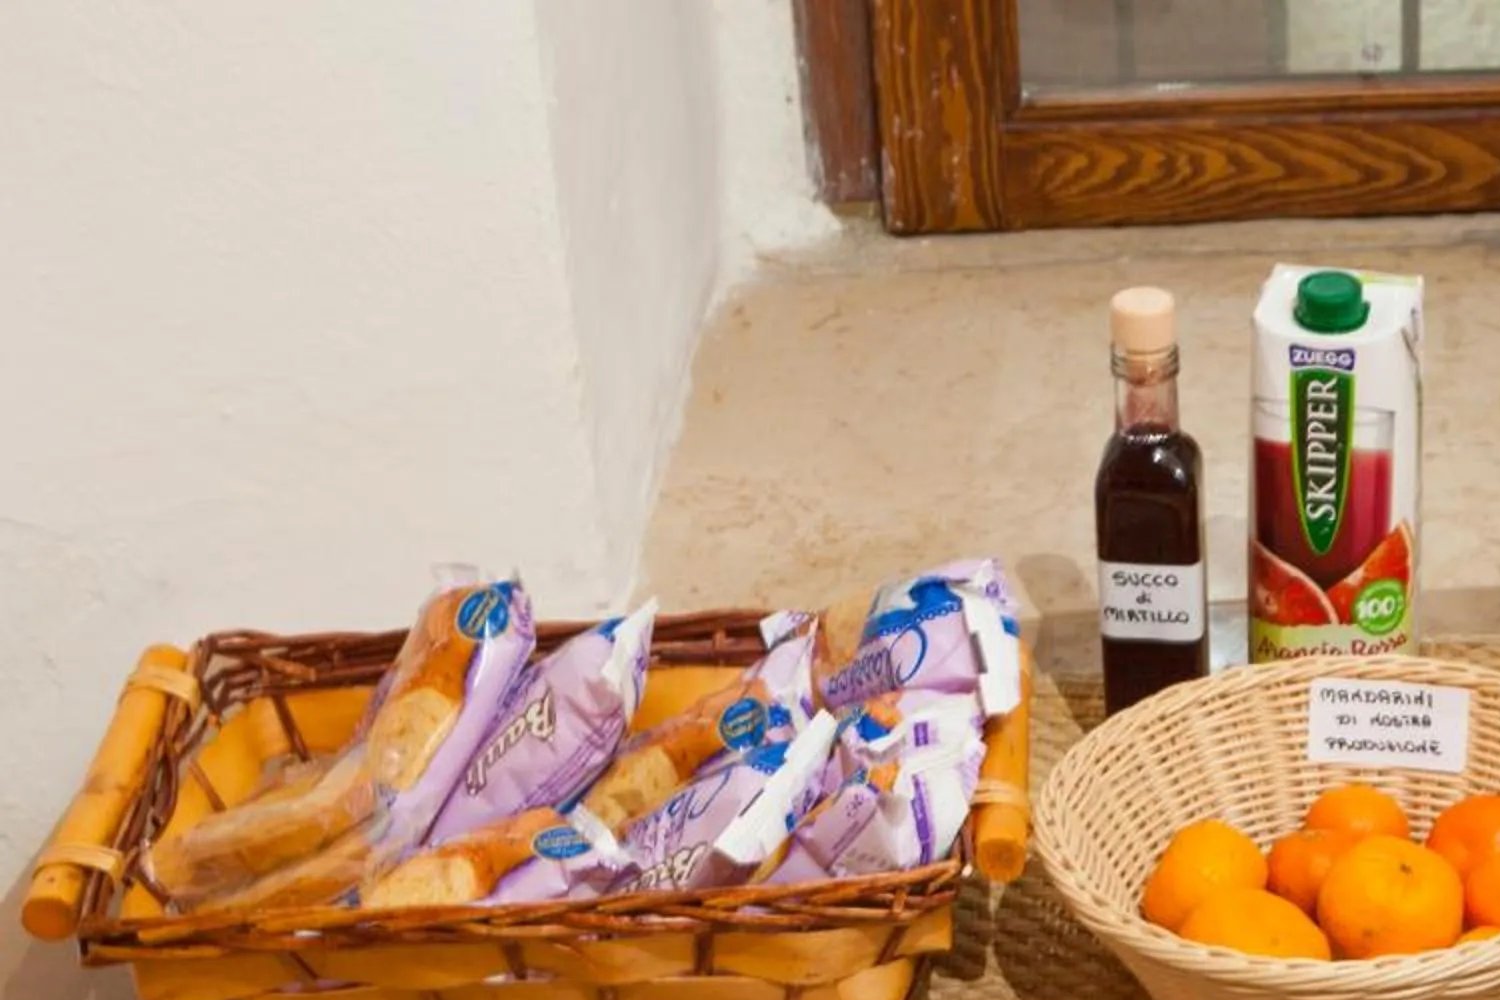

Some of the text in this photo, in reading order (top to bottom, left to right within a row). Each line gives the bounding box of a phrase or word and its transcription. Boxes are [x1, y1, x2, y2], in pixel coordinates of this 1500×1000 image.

[1292, 350, 1351, 366] ZUEGG
[1306, 375, 1338, 521] SKIPPER
[1112, 571, 1178, 588] SUCCO
[1103, 606, 1189, 624] MIRTILLO
[1320, 688, 1434, 708] MANDARINI
[465, 688, 556, 797] Bauli
